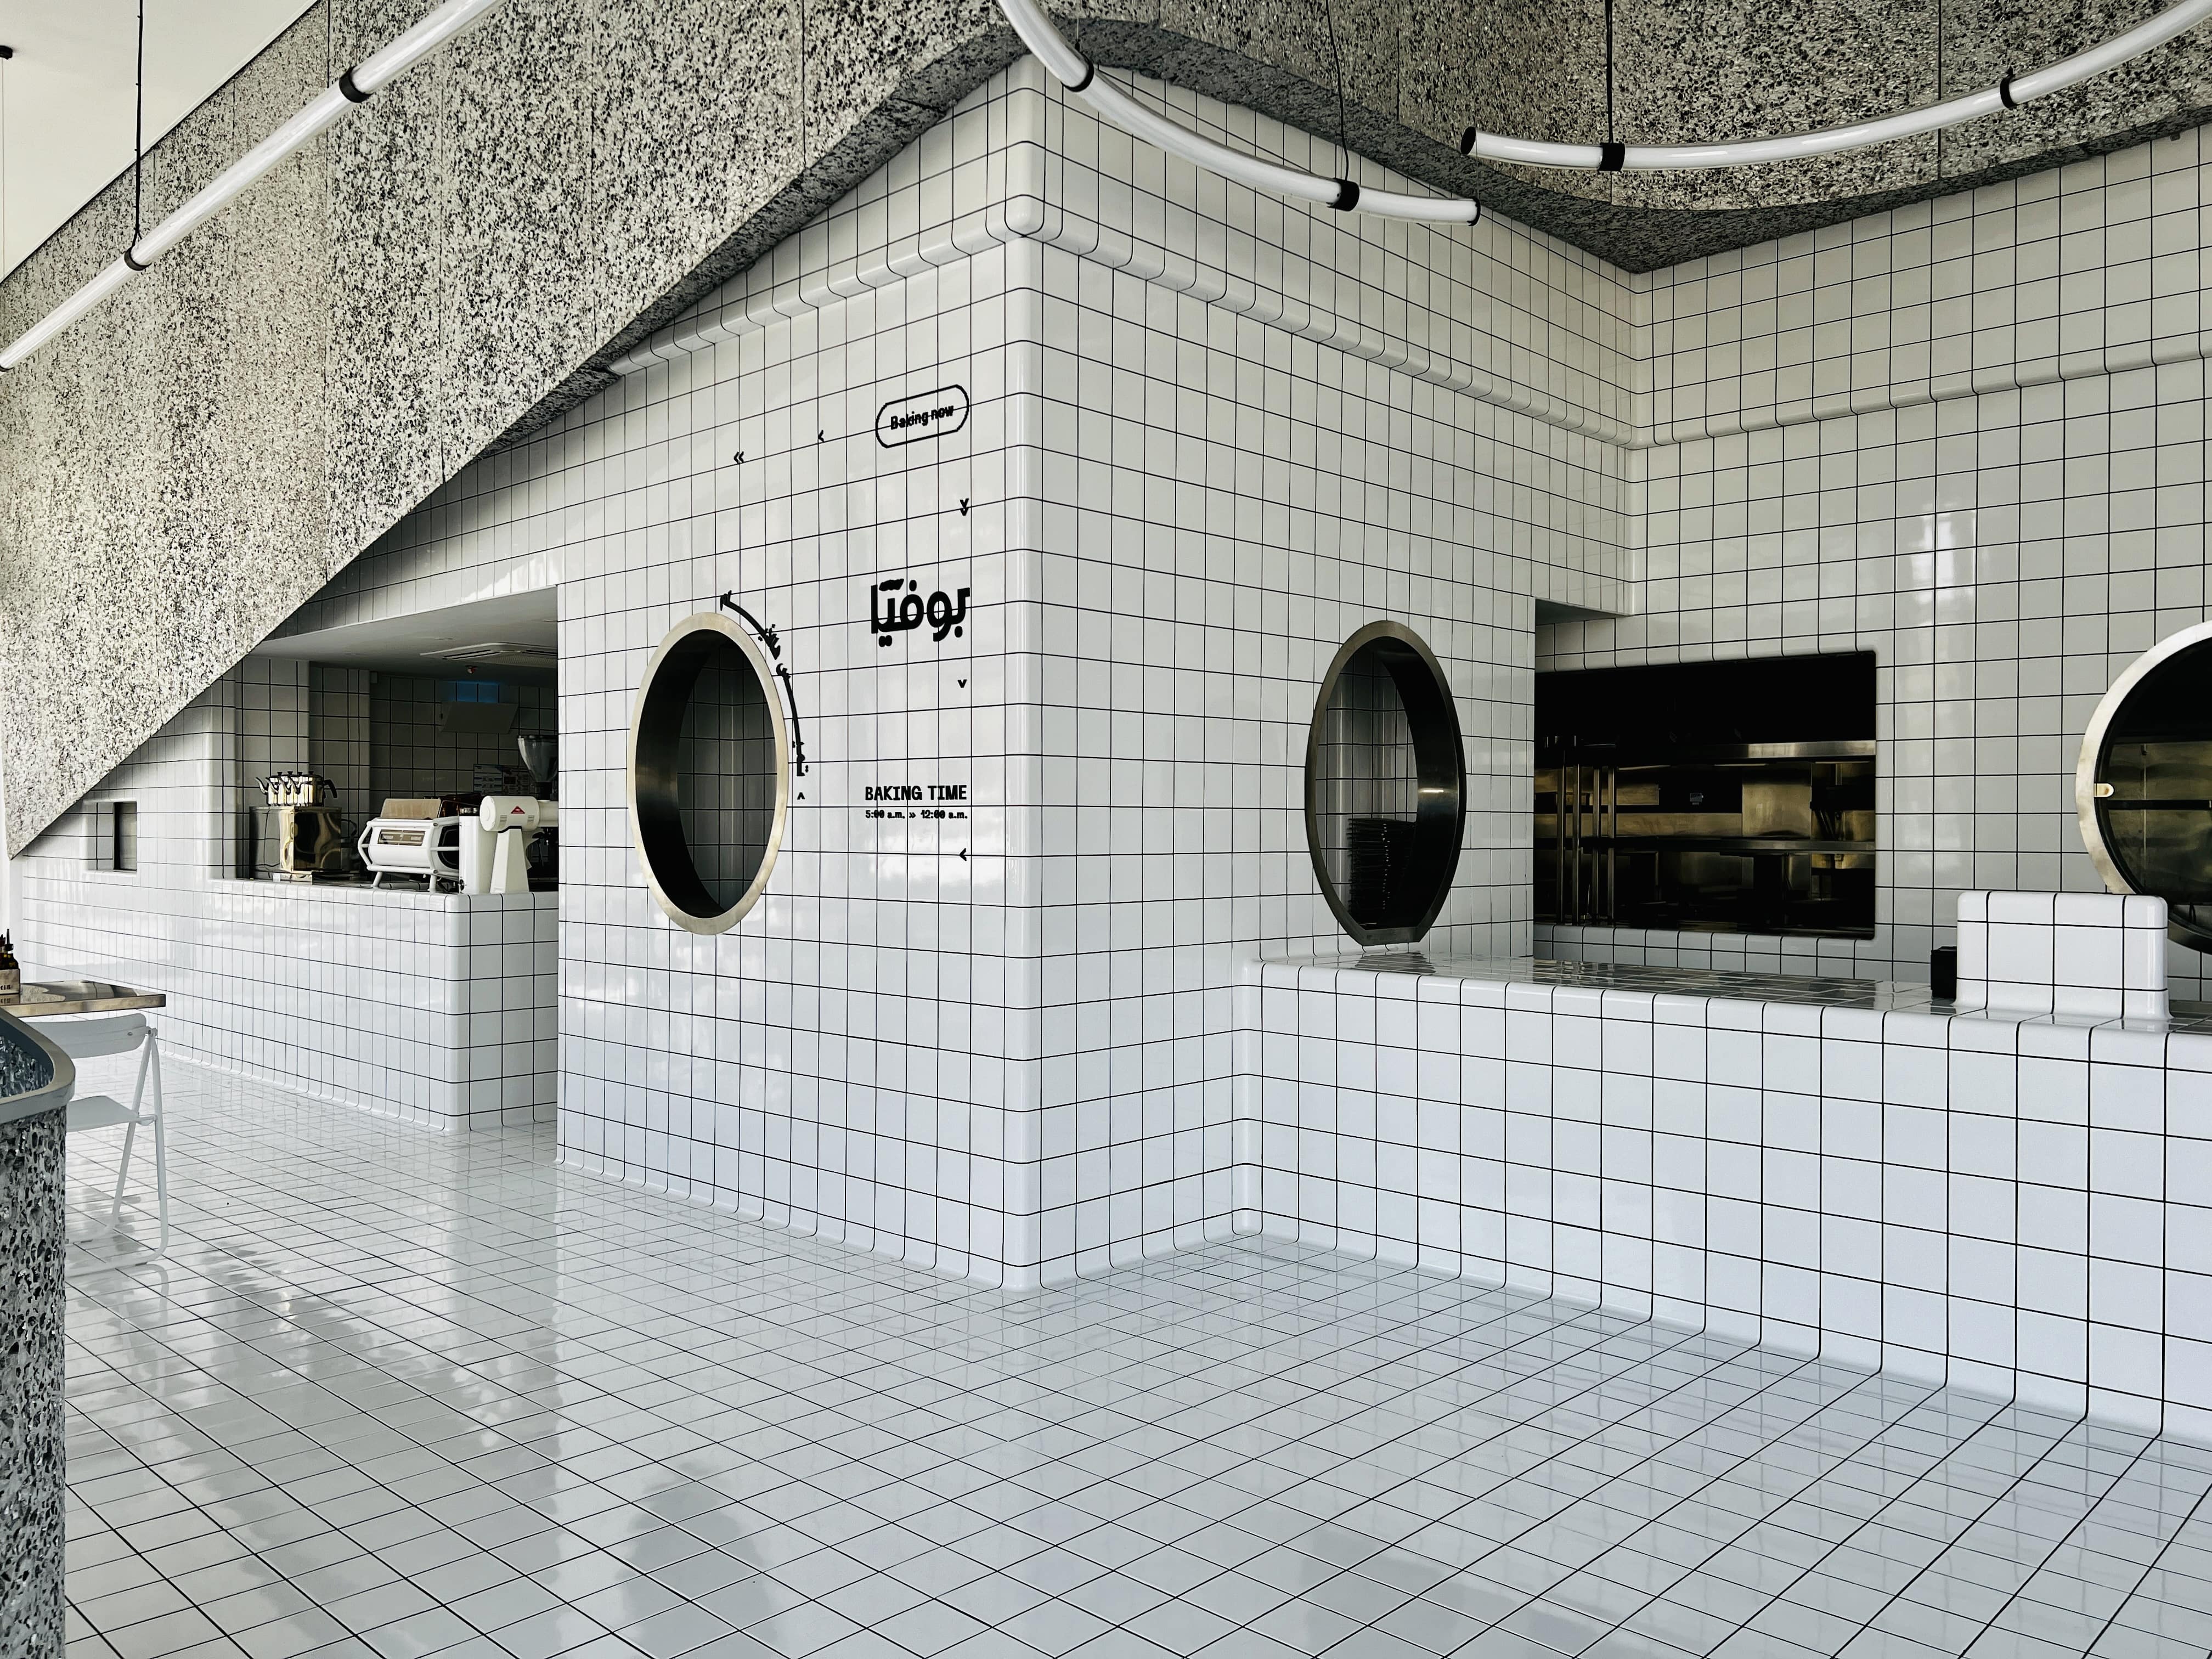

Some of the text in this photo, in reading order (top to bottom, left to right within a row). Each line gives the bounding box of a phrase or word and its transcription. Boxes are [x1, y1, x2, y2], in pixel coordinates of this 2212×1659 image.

[891, 405, 954, 430] Baking now
[776, 663, 810, 776] تميس
[865, 785, 967, 801] BAKING TIME
[866, 810, 885, 819] 5:00
[921, 809, 946, 819] 12:00
